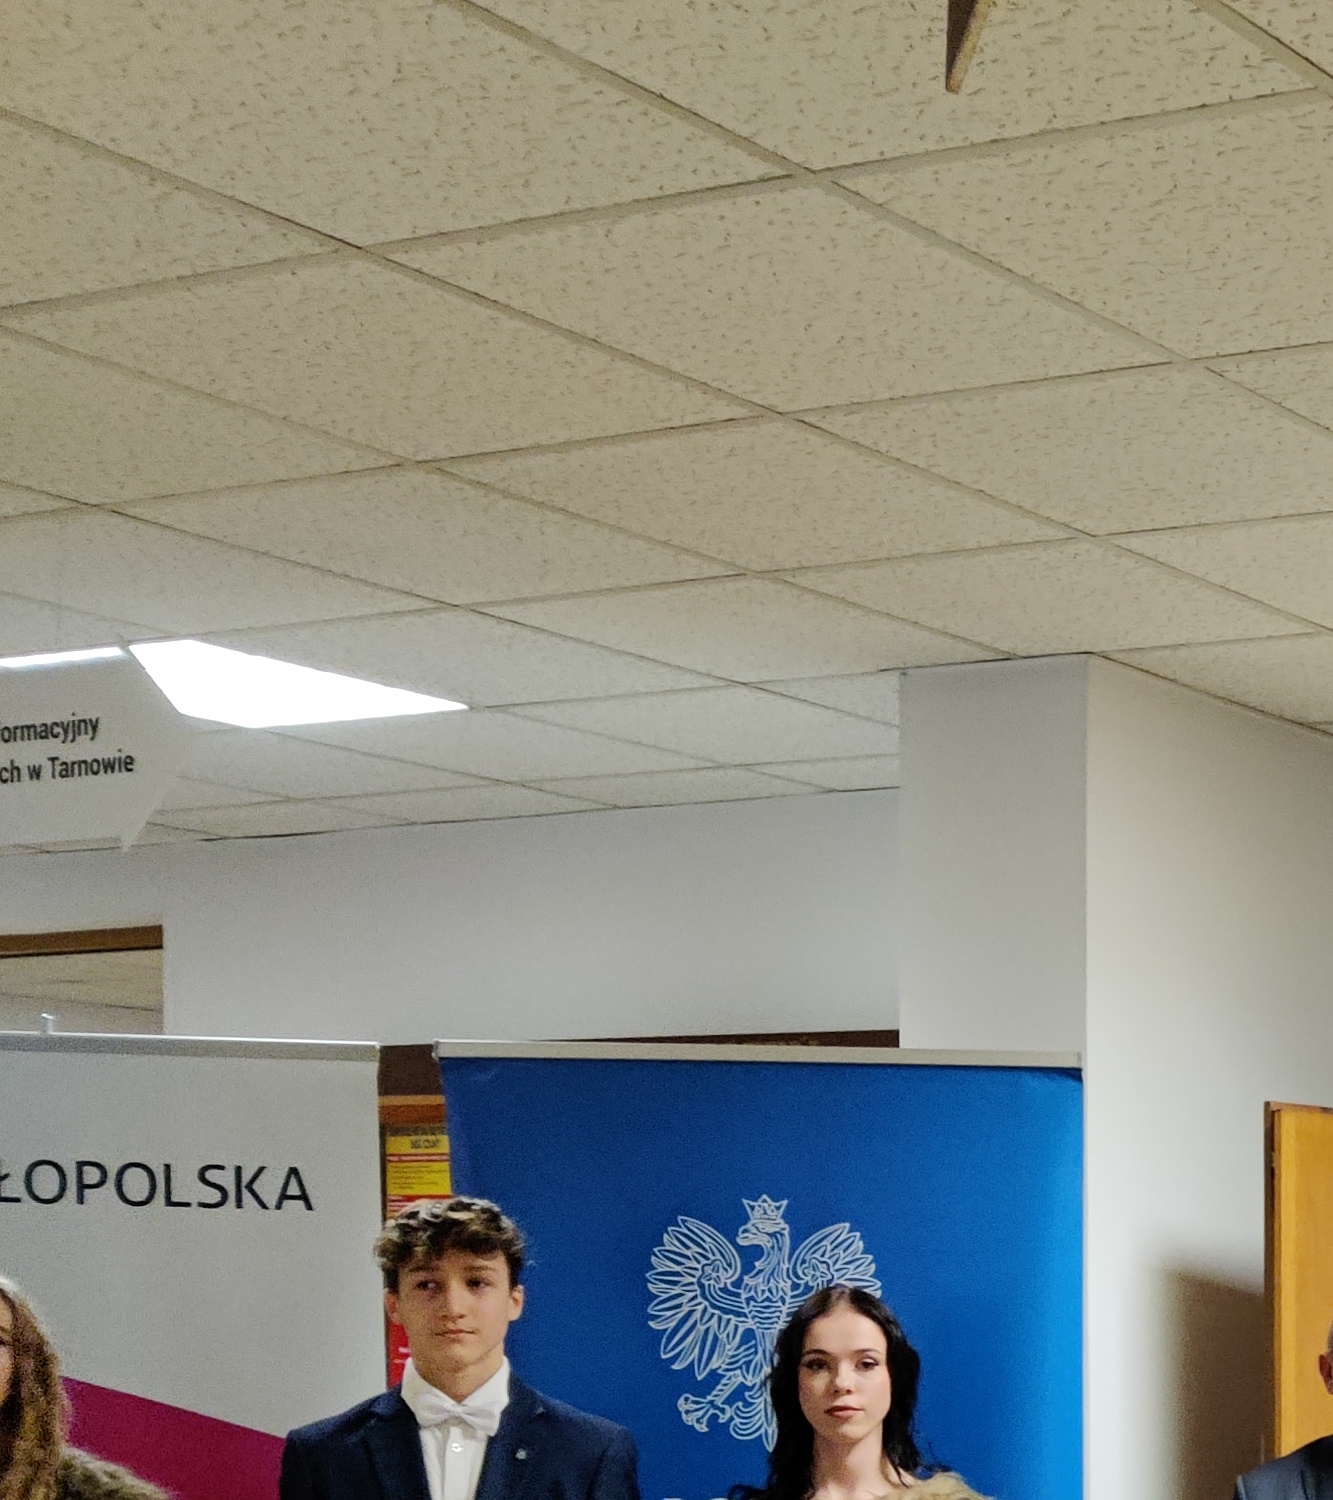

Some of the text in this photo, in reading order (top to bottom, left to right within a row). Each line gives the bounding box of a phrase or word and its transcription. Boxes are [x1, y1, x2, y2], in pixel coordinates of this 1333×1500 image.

[0, 711, 100, 744] ormacyjny
[27, 764, 42, 781] w
[47, 748, 136, 780] Tarnowie
